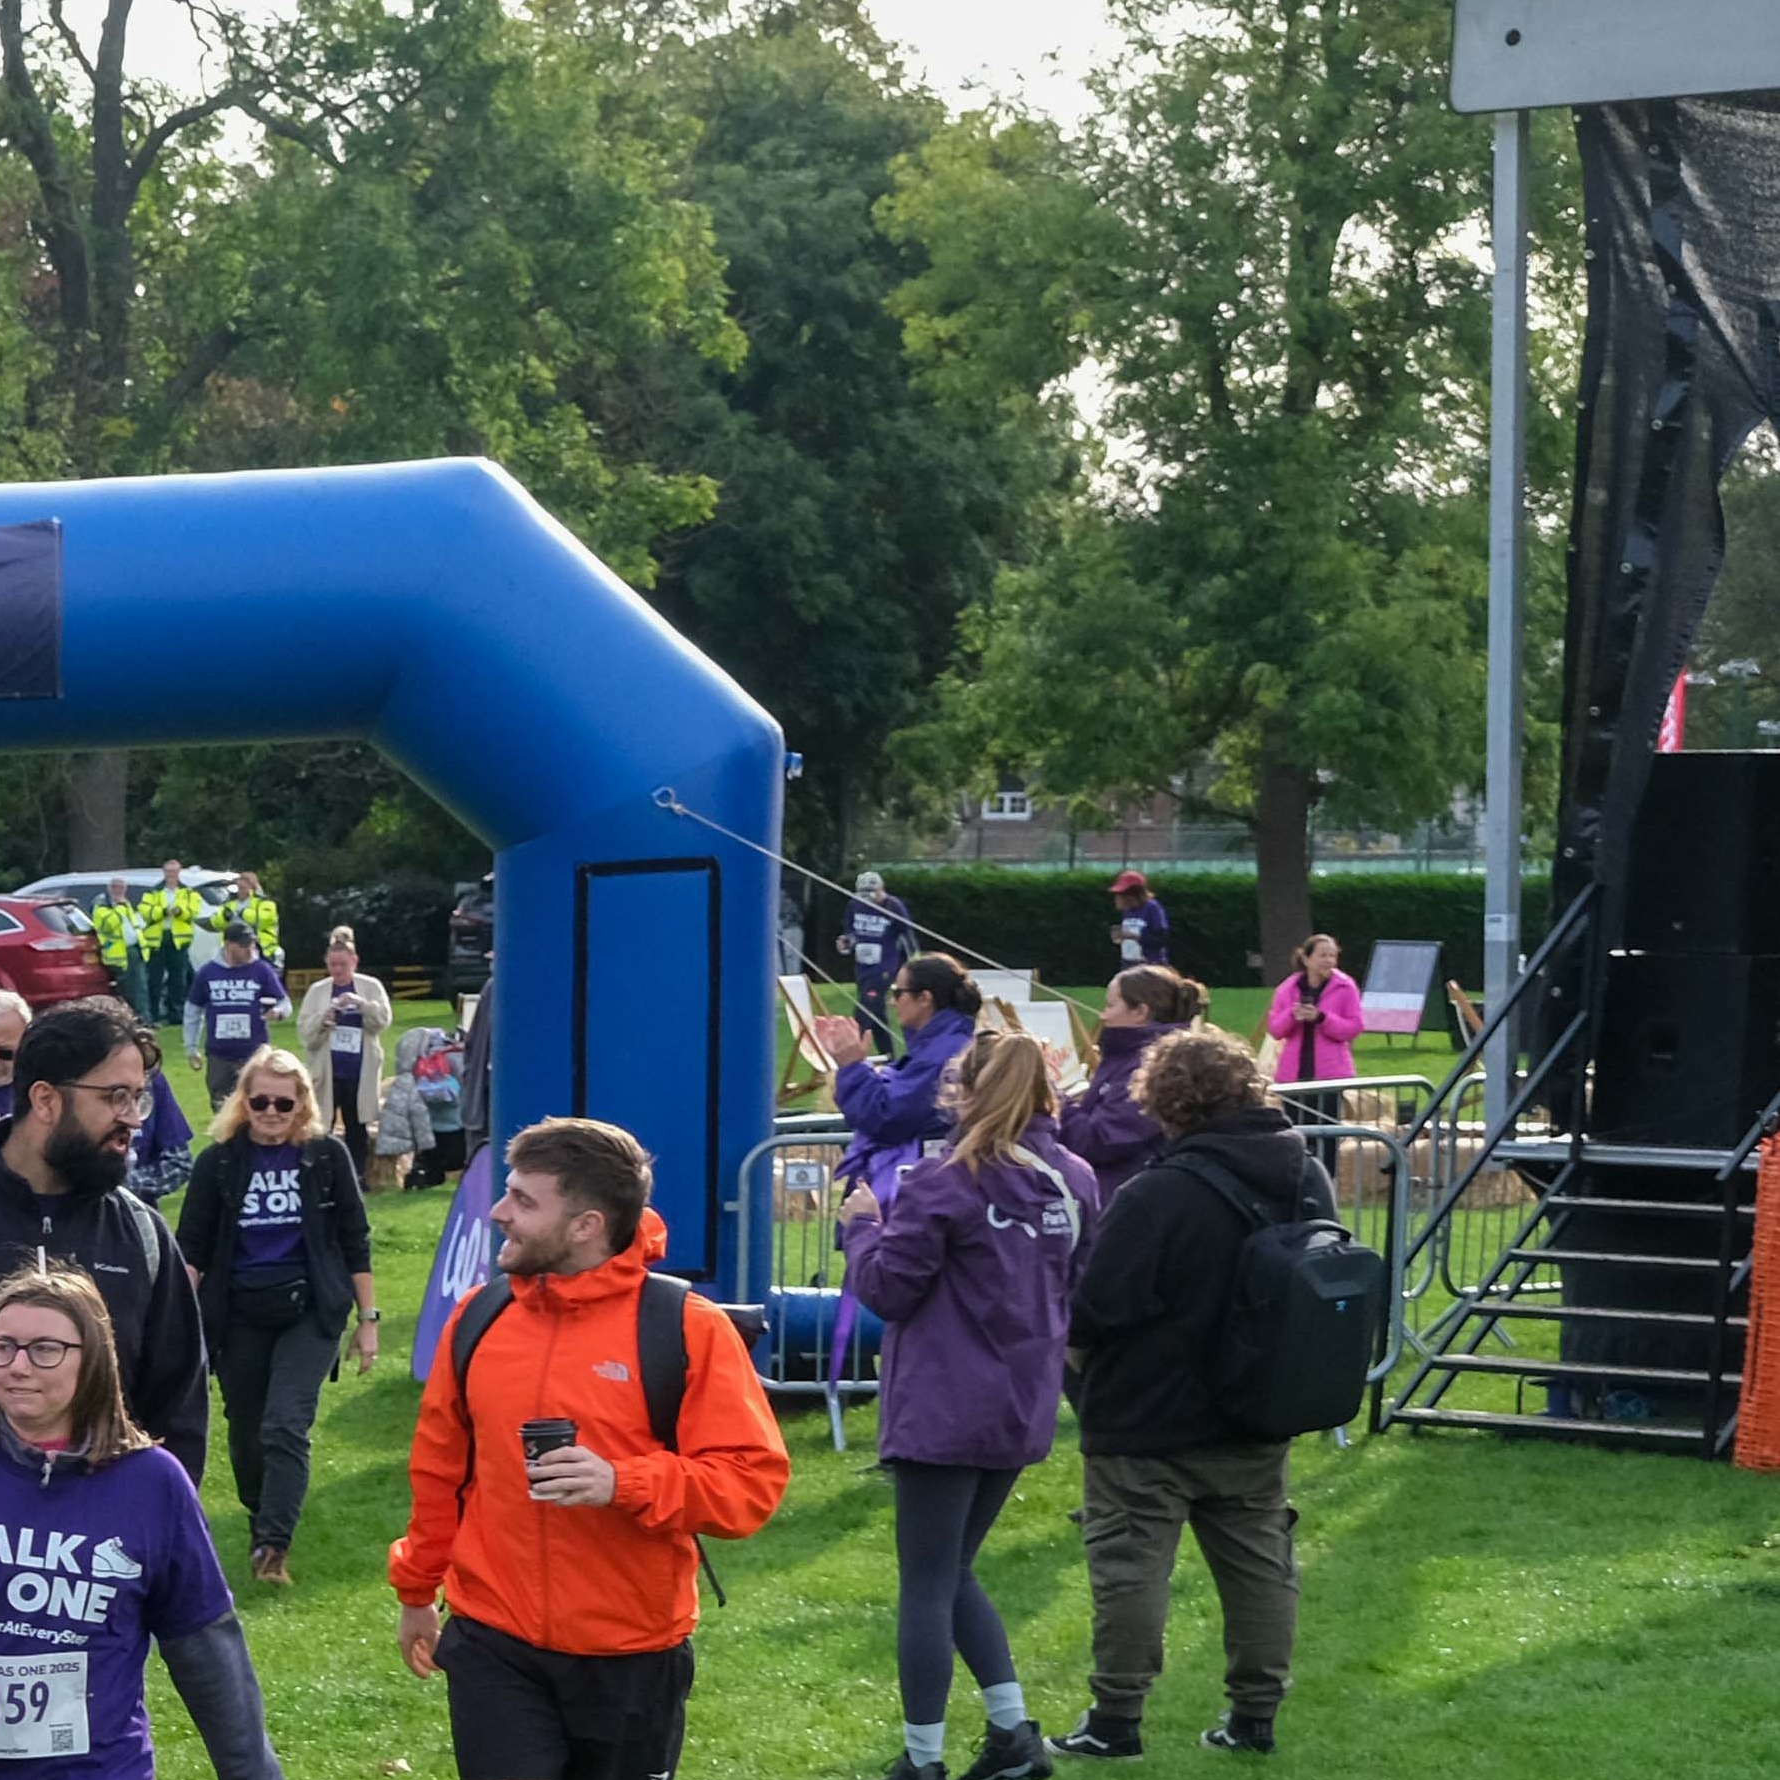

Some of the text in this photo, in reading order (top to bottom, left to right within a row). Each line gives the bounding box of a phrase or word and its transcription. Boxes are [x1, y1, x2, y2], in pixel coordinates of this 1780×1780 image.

[248, 1168, 301, 1193] ALK
[6, 1571, 117, 1624] ONE
[18, 1664, 47, 1677] ONE
[49, 1661, 81, 1675] 2025
